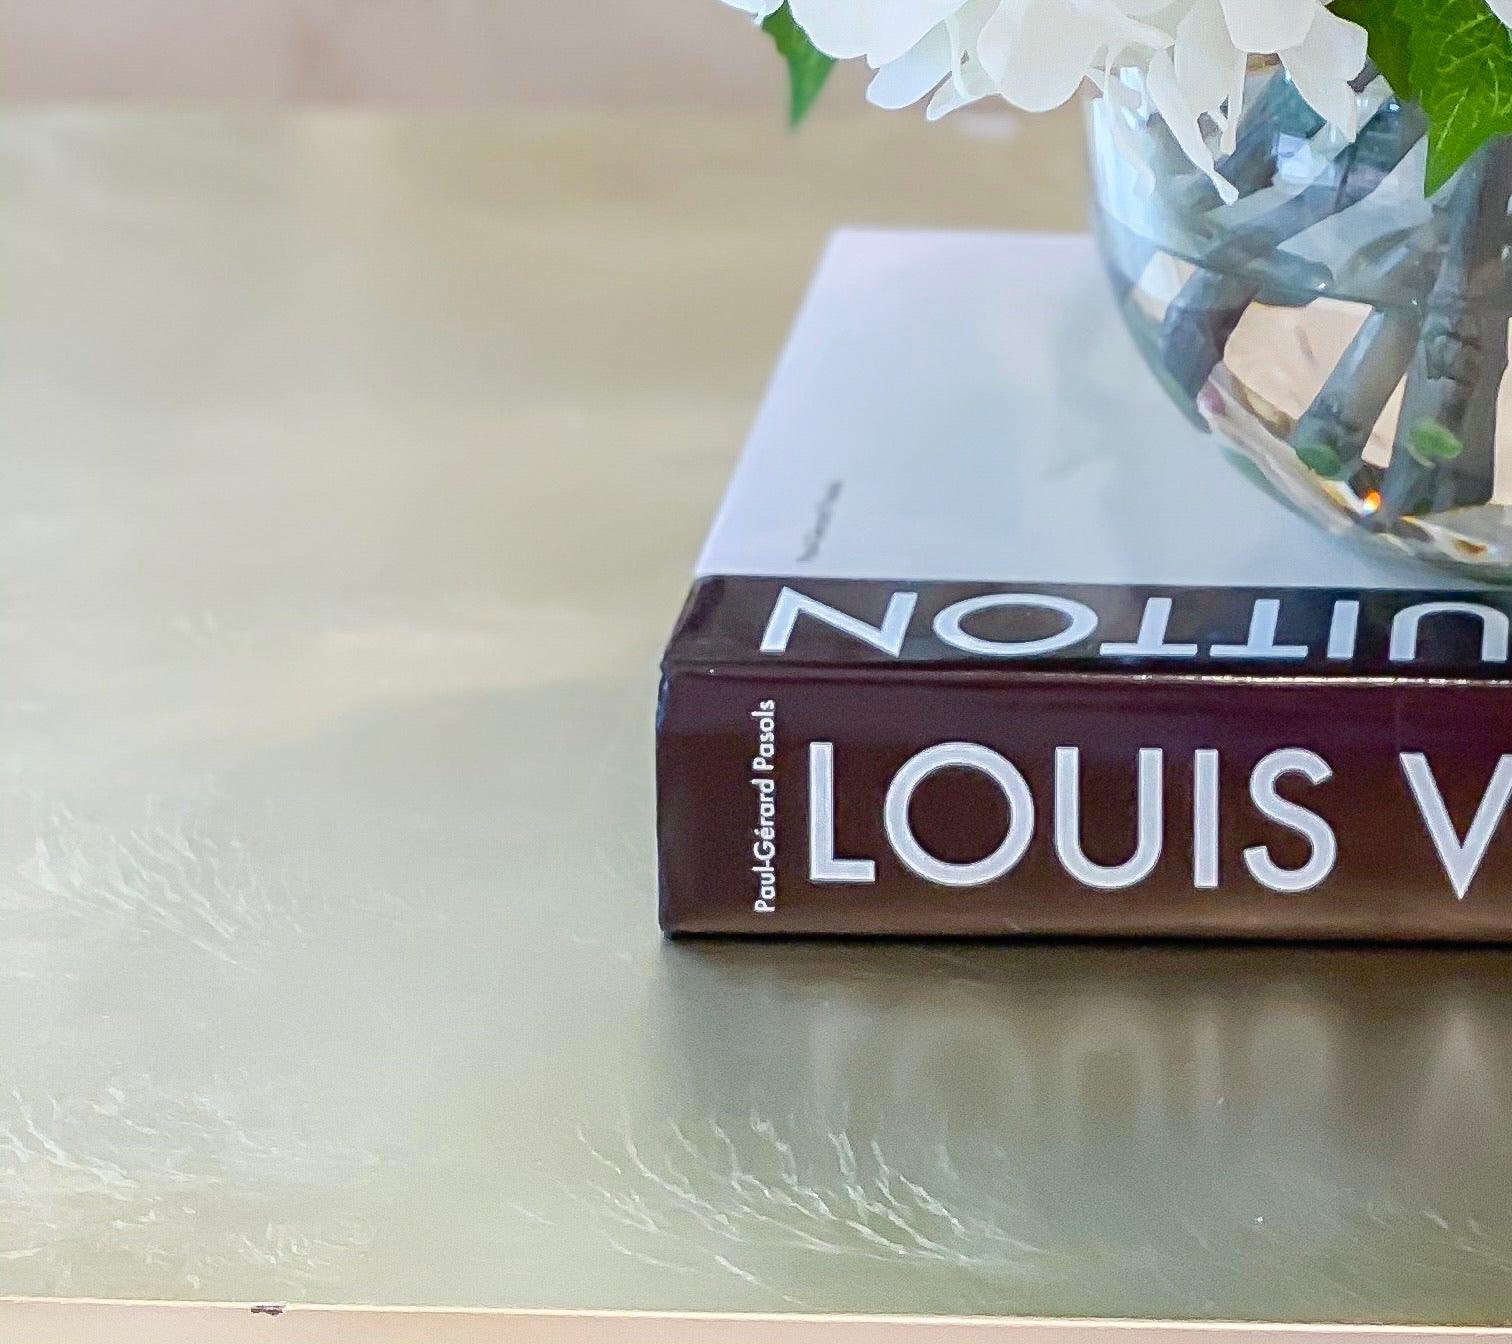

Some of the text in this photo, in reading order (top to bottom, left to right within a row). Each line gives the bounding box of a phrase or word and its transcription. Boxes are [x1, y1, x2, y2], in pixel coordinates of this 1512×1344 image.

[748, 698, 777, 914] Paul-Gérard Pasols
[808, 740, 1338, 894] LOUIS
